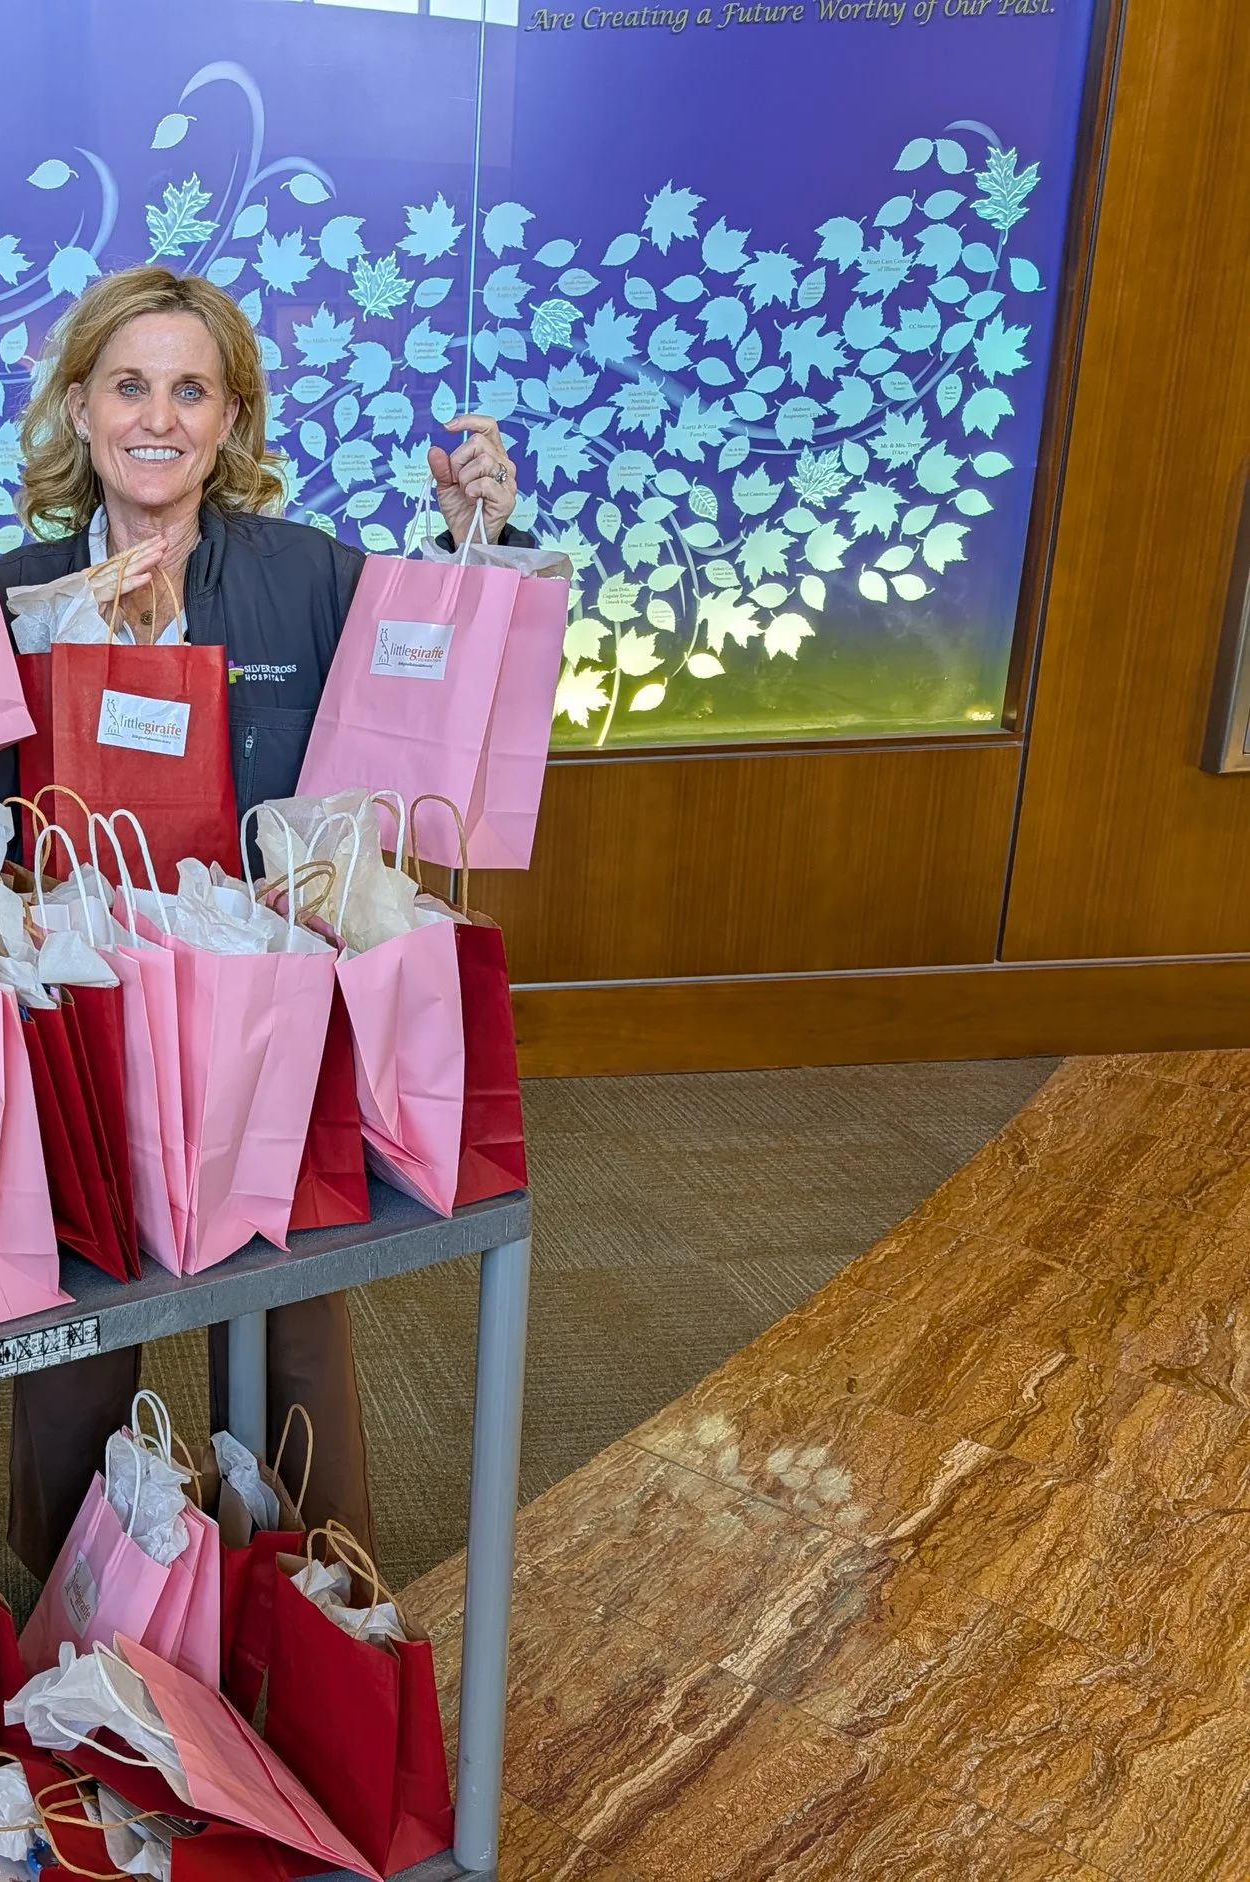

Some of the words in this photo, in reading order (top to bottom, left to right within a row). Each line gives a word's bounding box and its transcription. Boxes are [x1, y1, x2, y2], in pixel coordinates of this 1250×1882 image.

[525, 8, 575, 31] Are
[581, 5, 690, 33] Creating
[696, 8, 712, 24] a
[716, 2, 805, 29] Future
[812, 0, 906, 26] Worthy
[913, 0, 939, 26] of
[943, 0, 991, 17] Our
[389, 643, 444, 661] littlegiraffe
[244, 673, 286, 682] HOSPITAL
[120, 714, 182, 736] littlegiraffe
